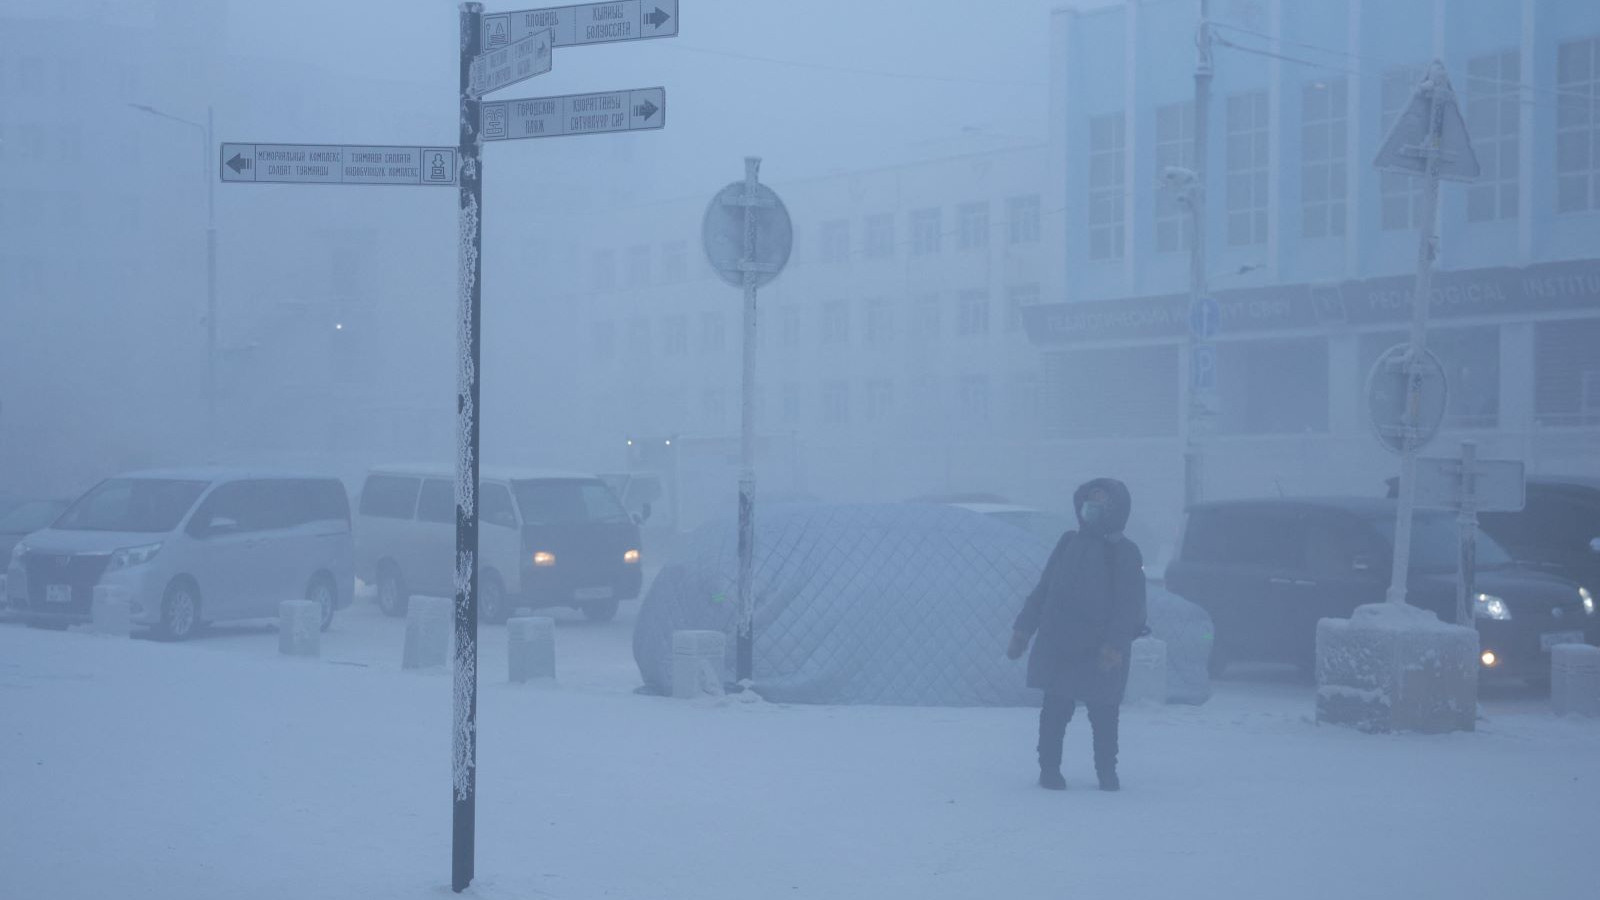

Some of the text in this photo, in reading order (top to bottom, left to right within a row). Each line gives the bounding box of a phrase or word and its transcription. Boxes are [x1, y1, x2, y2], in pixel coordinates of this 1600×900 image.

[525, 11, 559, 27] ПЛОЩАДЬ
[586, 21, 631, 40] БОЛУОССАТА
[517, 101, 555, 116] ГОРОДСКОЙ
[525, 119, 545, 135] ПЛЯЖ
[258, 151, 340, 163] МЕМОРИАЛЬНЫЙ КОМПЛЕКС
[268, 165, 291, 176] СОЛДАТ
[388, 167, 418, 177] КОМПЛЕКС
[1368, 281, 1506, 309] PEDAOGICAL
